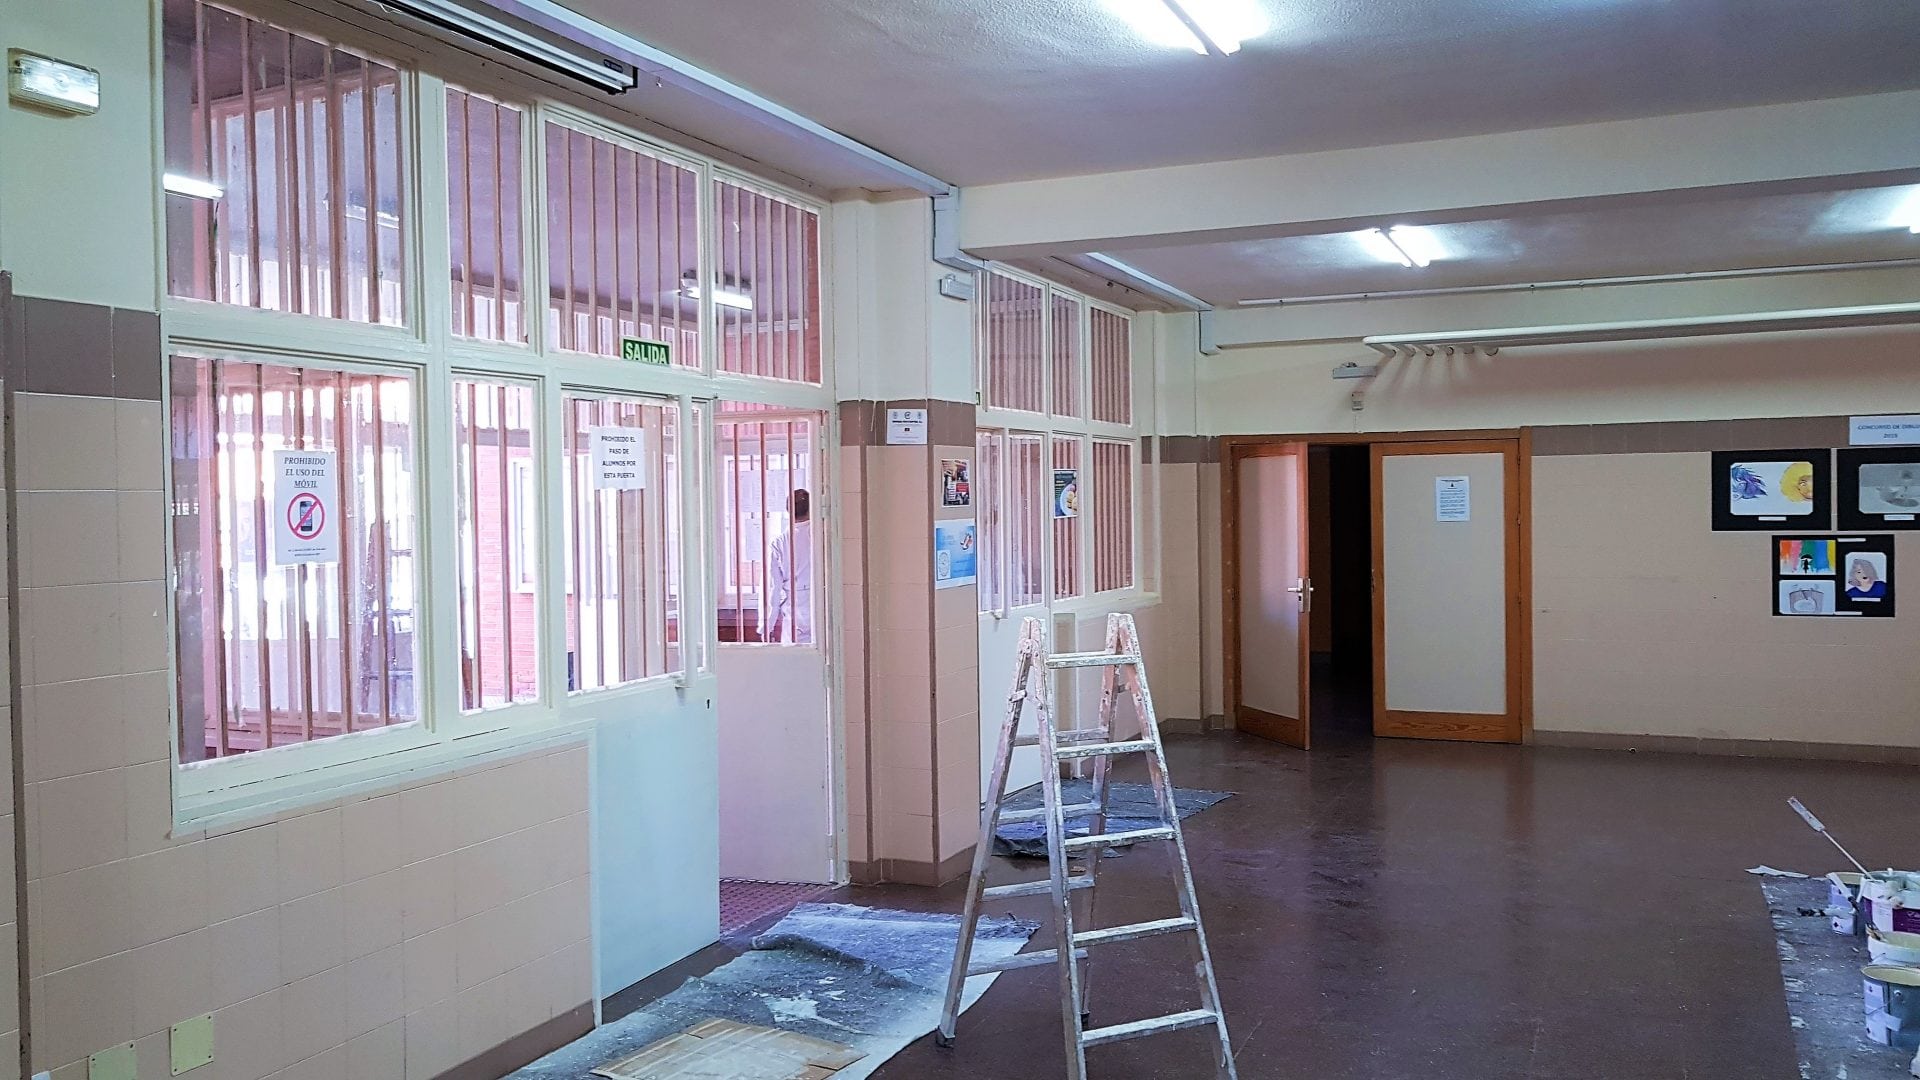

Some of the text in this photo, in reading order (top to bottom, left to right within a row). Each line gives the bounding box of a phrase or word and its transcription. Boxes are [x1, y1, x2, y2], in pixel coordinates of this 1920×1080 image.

[625, 342, 668, 365] SALIDA
[600, 435, 629, 443] PROHIBIDO
[284, 456, 327, 466] PROHIBIDO
[285, 468, 326, 477] EL USO DEL
[294, 479, 318, 489] MÓVIL
